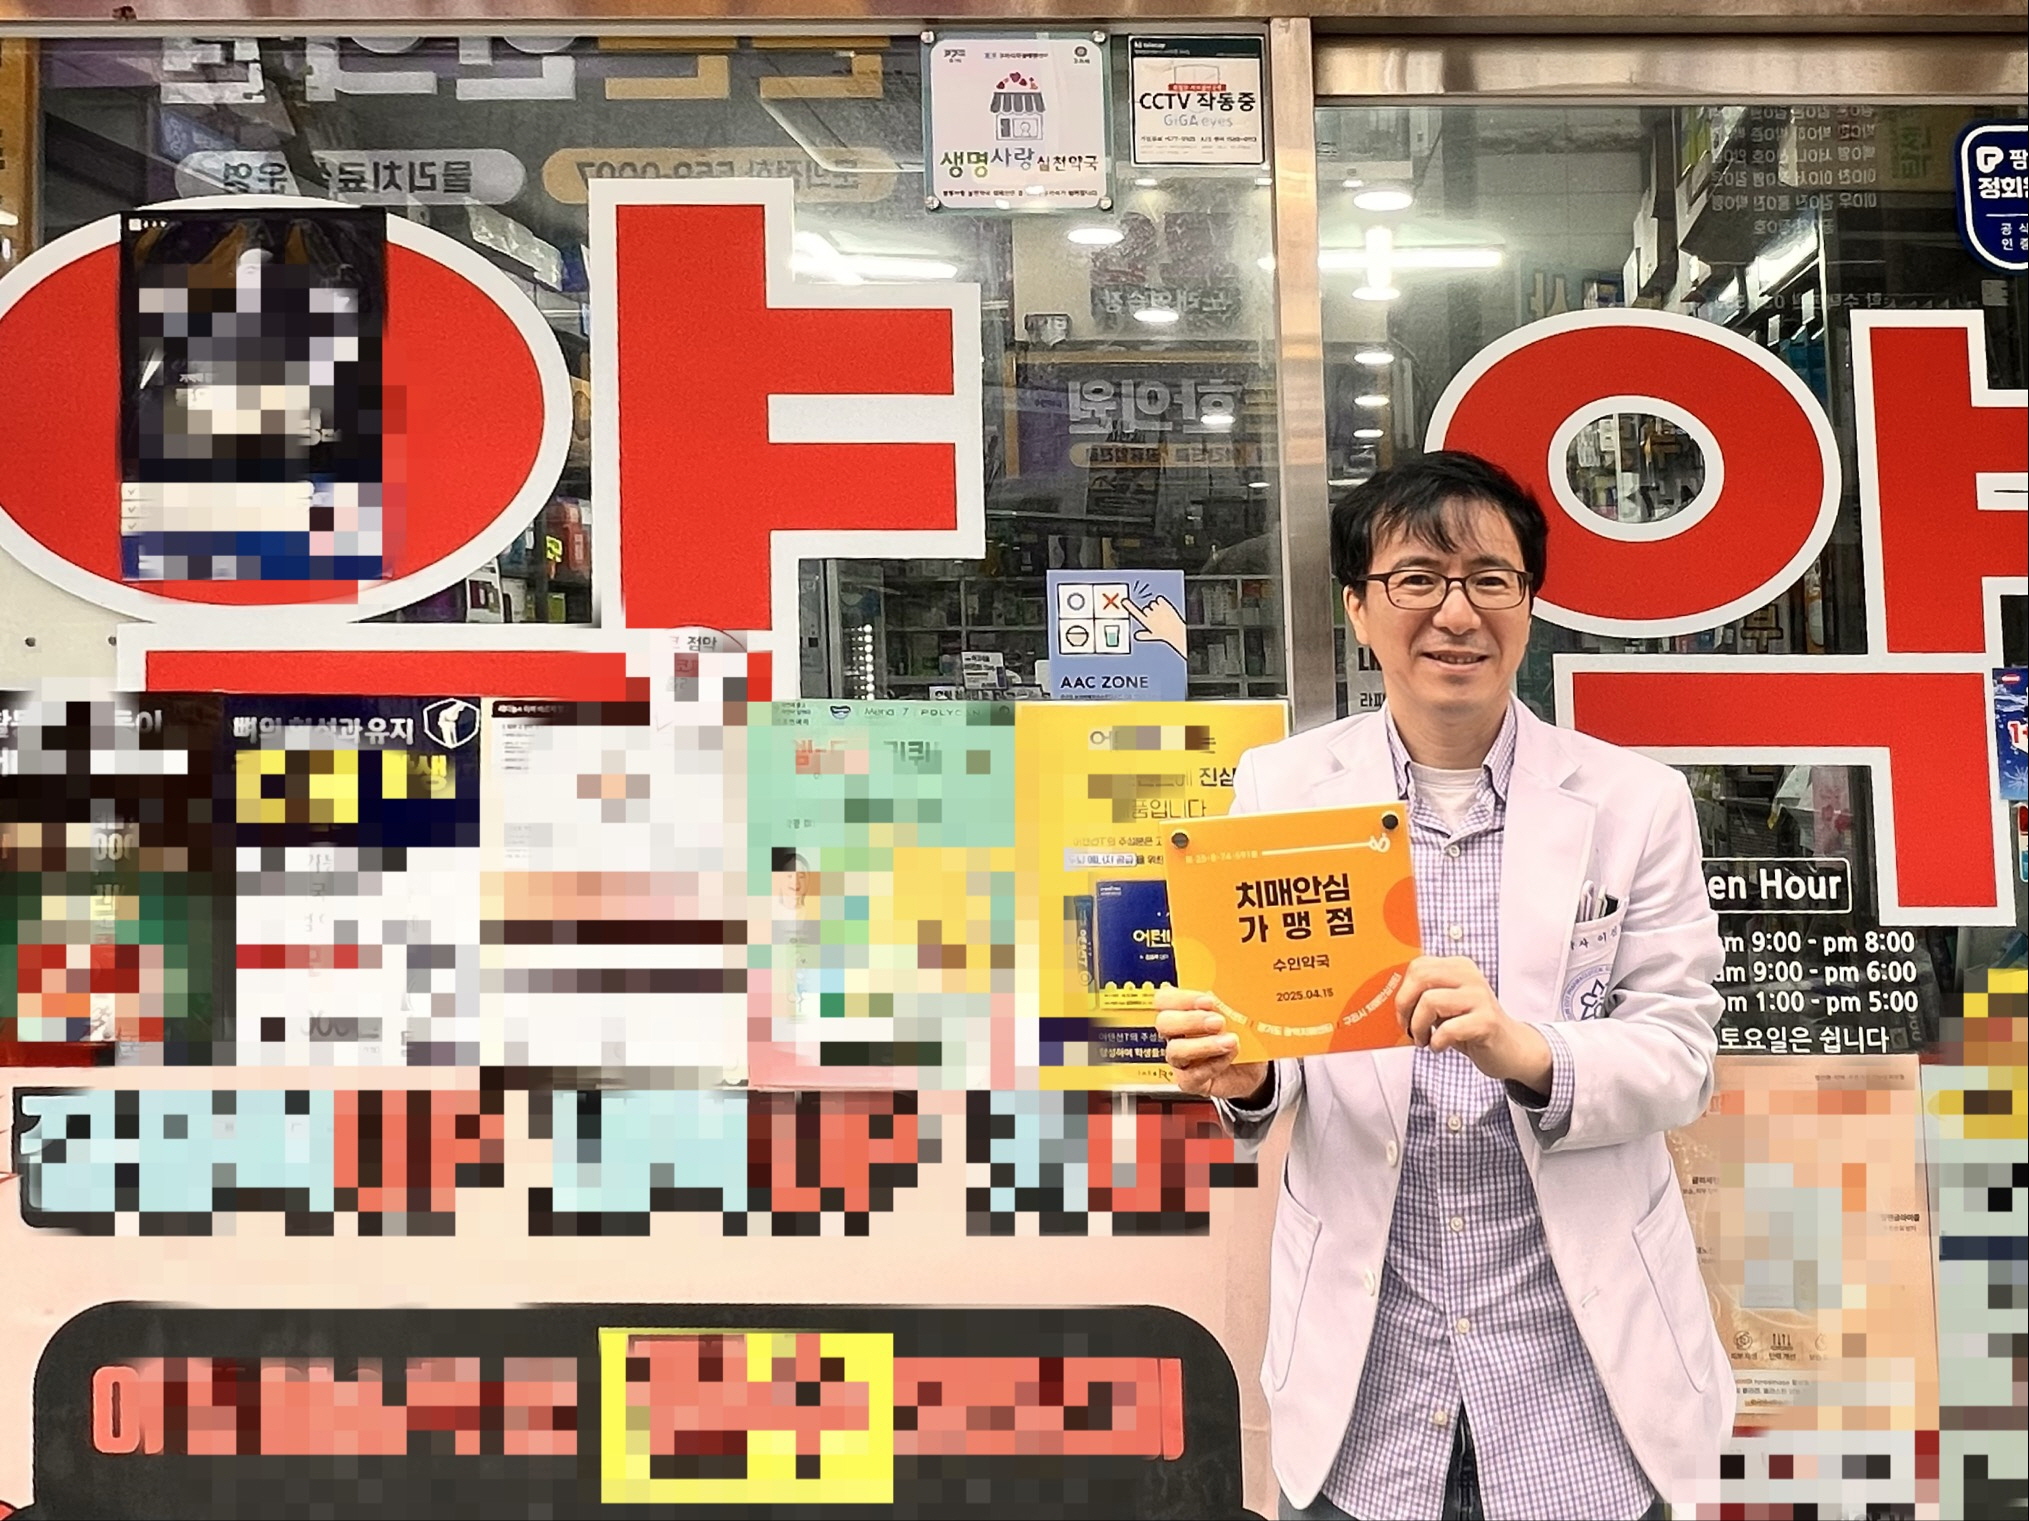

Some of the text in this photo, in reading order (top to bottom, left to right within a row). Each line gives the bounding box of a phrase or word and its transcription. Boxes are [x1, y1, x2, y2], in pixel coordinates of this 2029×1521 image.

[1140, 91, 1256, 112] CCTV 작동중
[1060, 676, 1149, 690] AAC ZONE
[920, 708, 981, 717] POLYCN
[363, 716, 415, 746] 유지
[1235, 873, 1352, 909] 치매안심
[1708, 868, 1842, 900] en Hour
[1723, 935, 1744, 952] m
[1751, 931, 1801, 953] 9:00
[1823, 935, 1858, 956] pm
[1864, 931, 1915, 953] 8:00
[1273, 954, 1330, 972] 수인약국
[1753, 960, 1803, 982] 9:00
[1824, 965, 1860, 986] pm
[1866, 960, 1917, 982] 6:00
[1723, 995, 1748, 1012] m
[1756, 990, 1805, 1012] 1:00
[1826, 995, 1862, 1016] pm
[1868, 990, 1919, 1012] 5:00
[1719, 1026, 1813, 1053] 토요일은
[1819, 1026, 1889, 1053] 쉽니다
